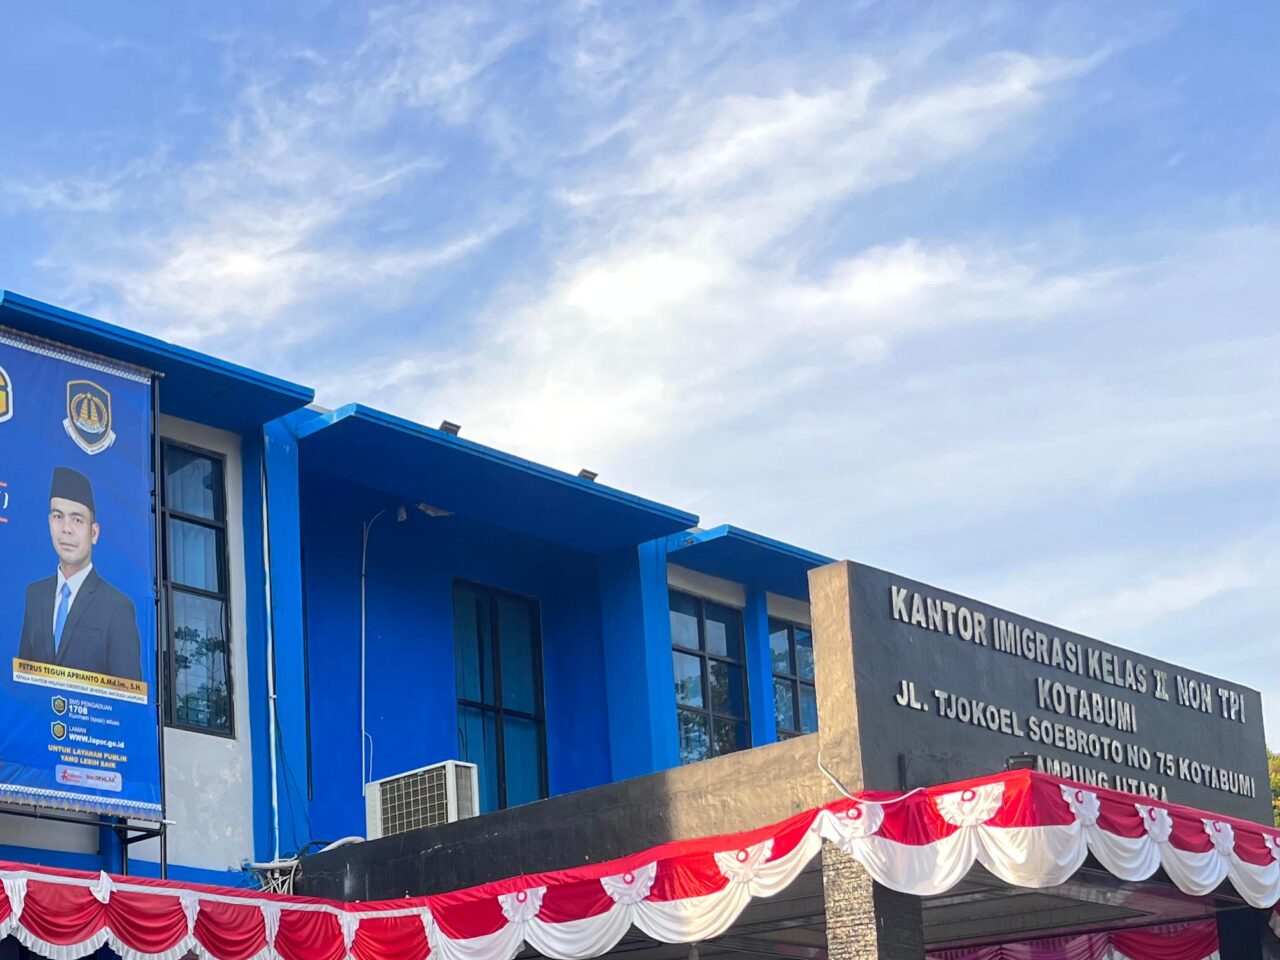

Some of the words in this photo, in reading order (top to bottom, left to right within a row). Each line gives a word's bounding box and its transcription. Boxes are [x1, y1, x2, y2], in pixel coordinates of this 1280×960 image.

[18, 662, 43, 672] PETRUS
[43, 667, 66, 677] TEGUH
[67, 671, 99, 683] APRIANTO
[891, 585, 987, 647] KANTOR
[993, 617, 1084, 675] IMIGRASI
[1087, 647, 1147, 694] KELAS
[1176, 675, 1213, 714] NON
[1218, 688, 1246, 724] TPI
[69, 705, 88, 715] 1708
[1037, 677, 1138, 733] KOTABUMI
[48, 744, 71, 754] UNTUK
[104, 752, 128, 762] PUBLIK
[895, 680, 929, 712] JL.
[934, 689, 1024, 737] TJOKOEL
[1028, 715, 1122, 763] SOEBROTO
[1126, 744, 1151, 771] NO
[1155, 752, 1176, 777] 75
[1179, 758, 1256, 799] KOTABUMI
[1024, 752, 1109, 790] AMPUNG
